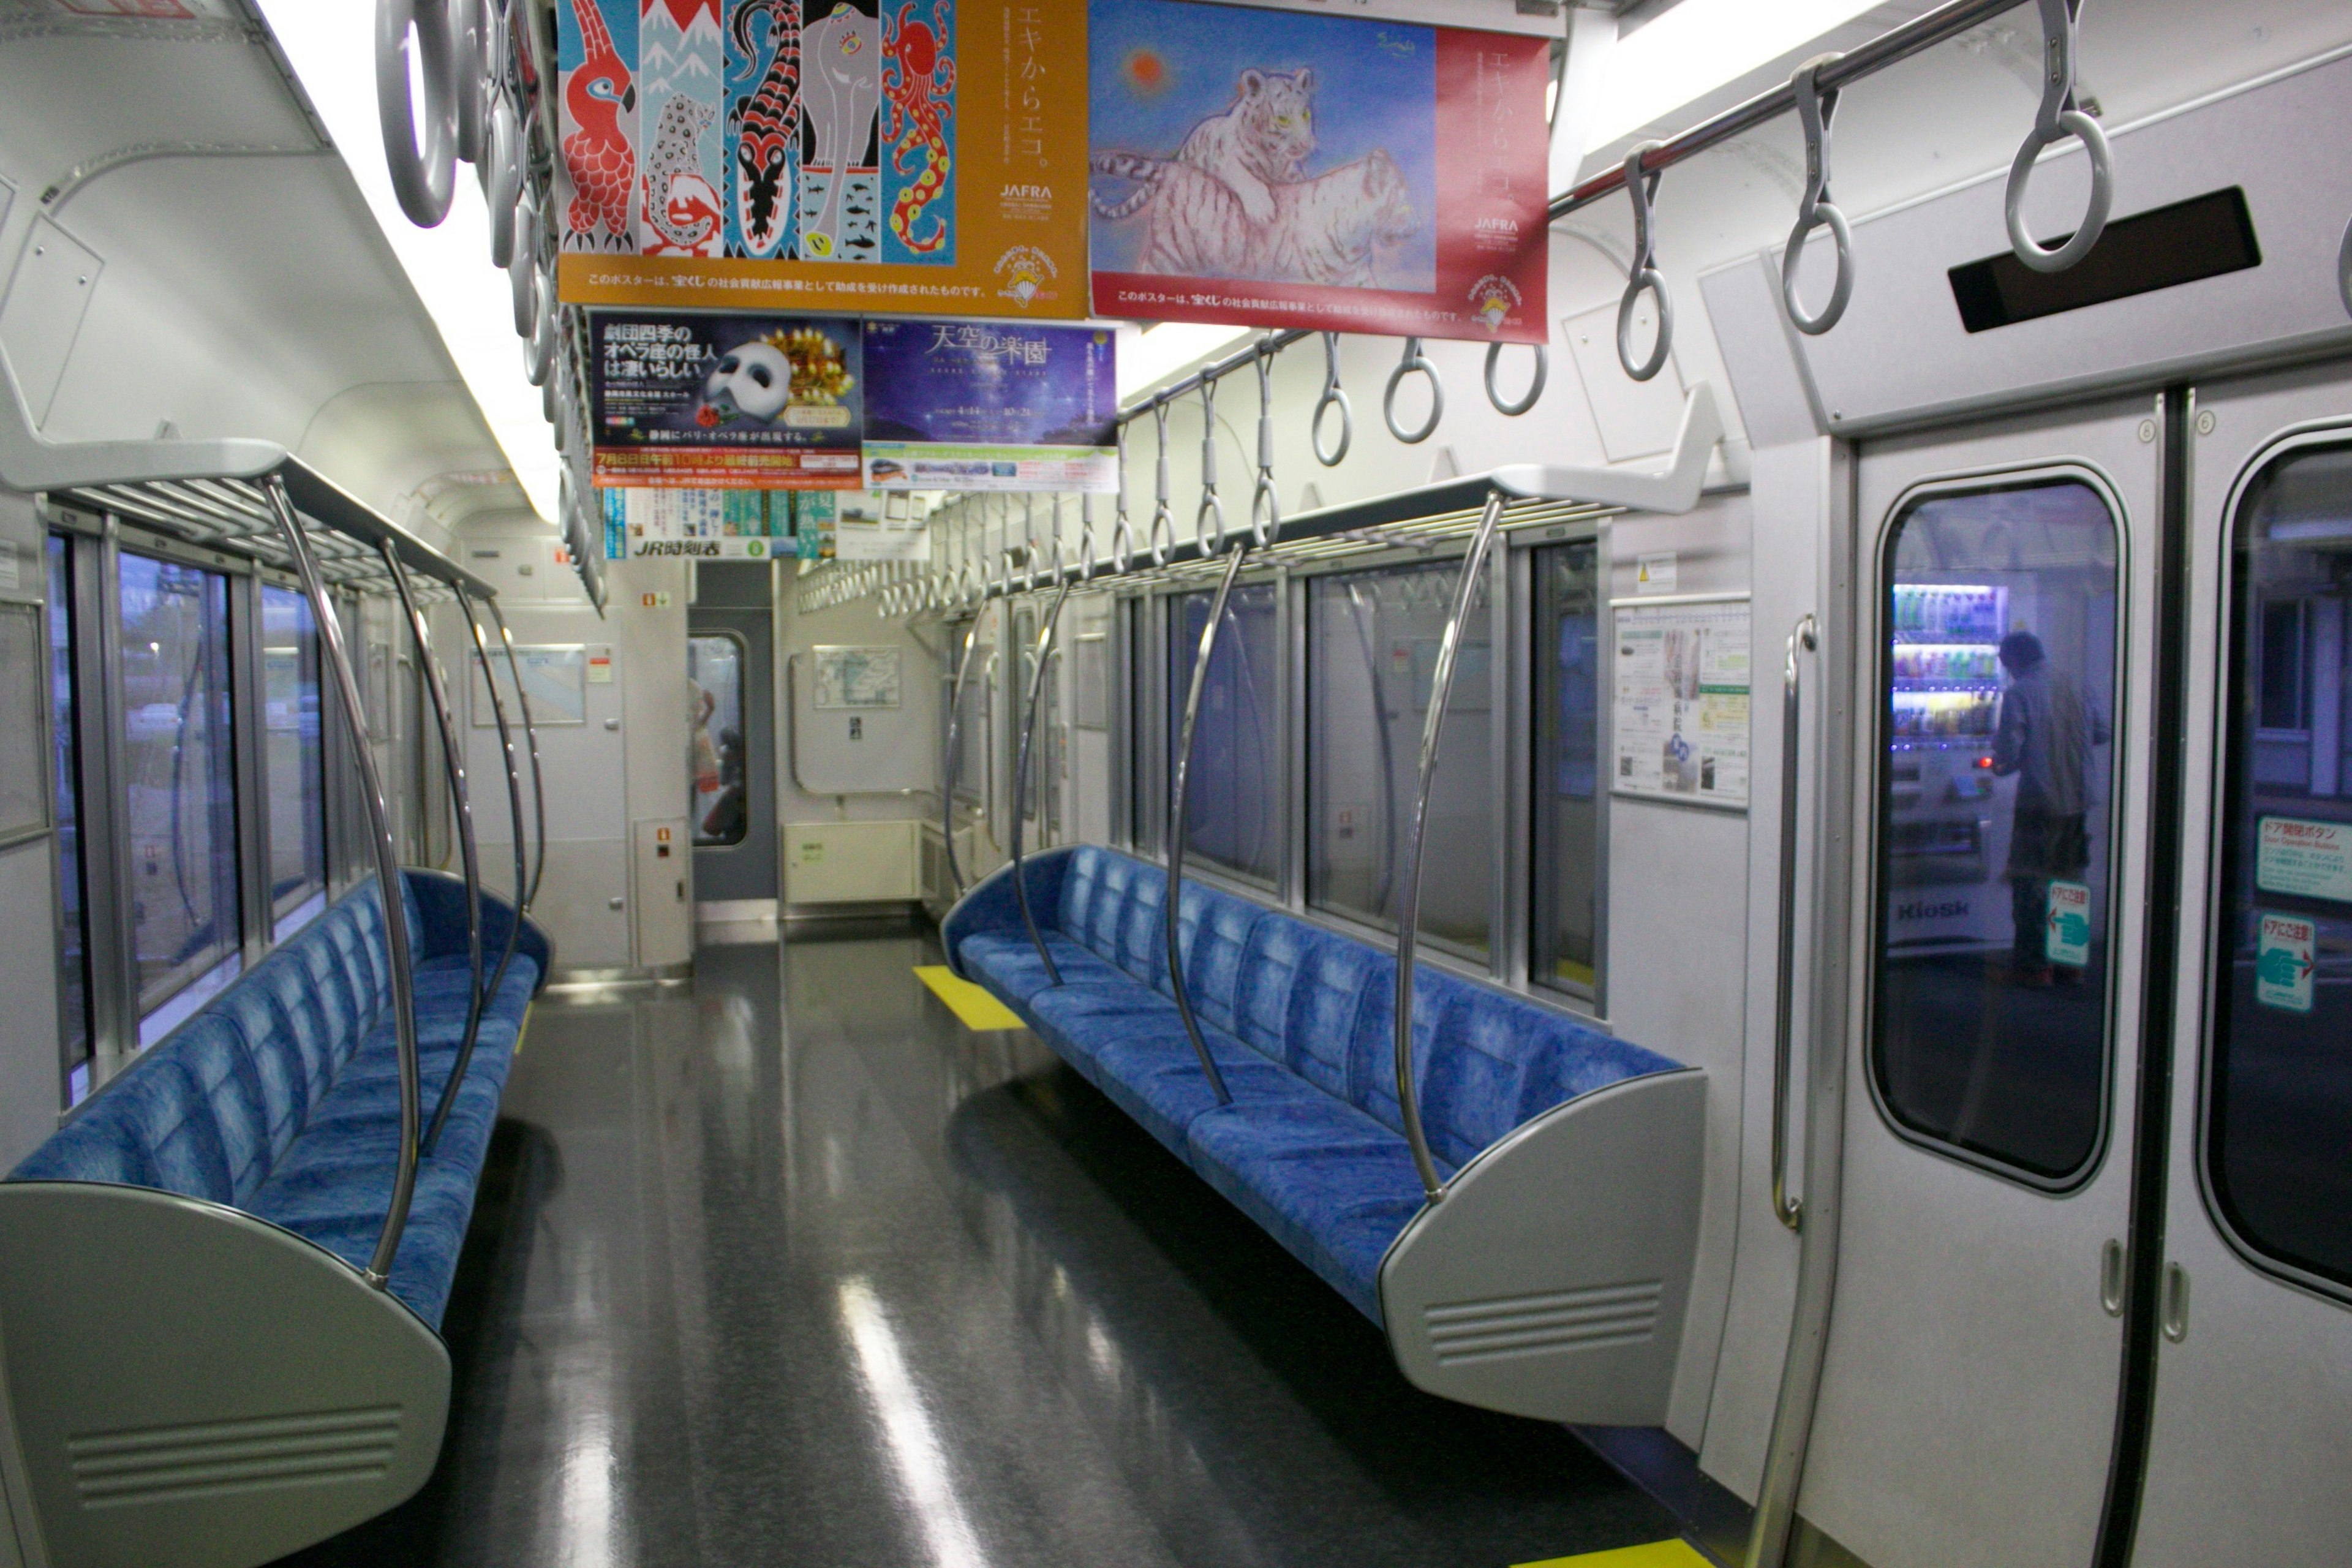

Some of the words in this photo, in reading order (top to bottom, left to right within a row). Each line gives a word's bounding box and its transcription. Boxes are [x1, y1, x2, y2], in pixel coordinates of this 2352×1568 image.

[1000, 184, 1052, 198] JAFRA
[1474, 217, 1519, 232] JAFRA
[603, 323, 692, 342] 劇団四季の
[603, 342, 718, 361] オペラ座の怪人
[925, 325, 1053, 365] 天空の楽園
[633, 540, 721, 556] JR時刻表
[1898, 899, 1970, 921] Kiosk
